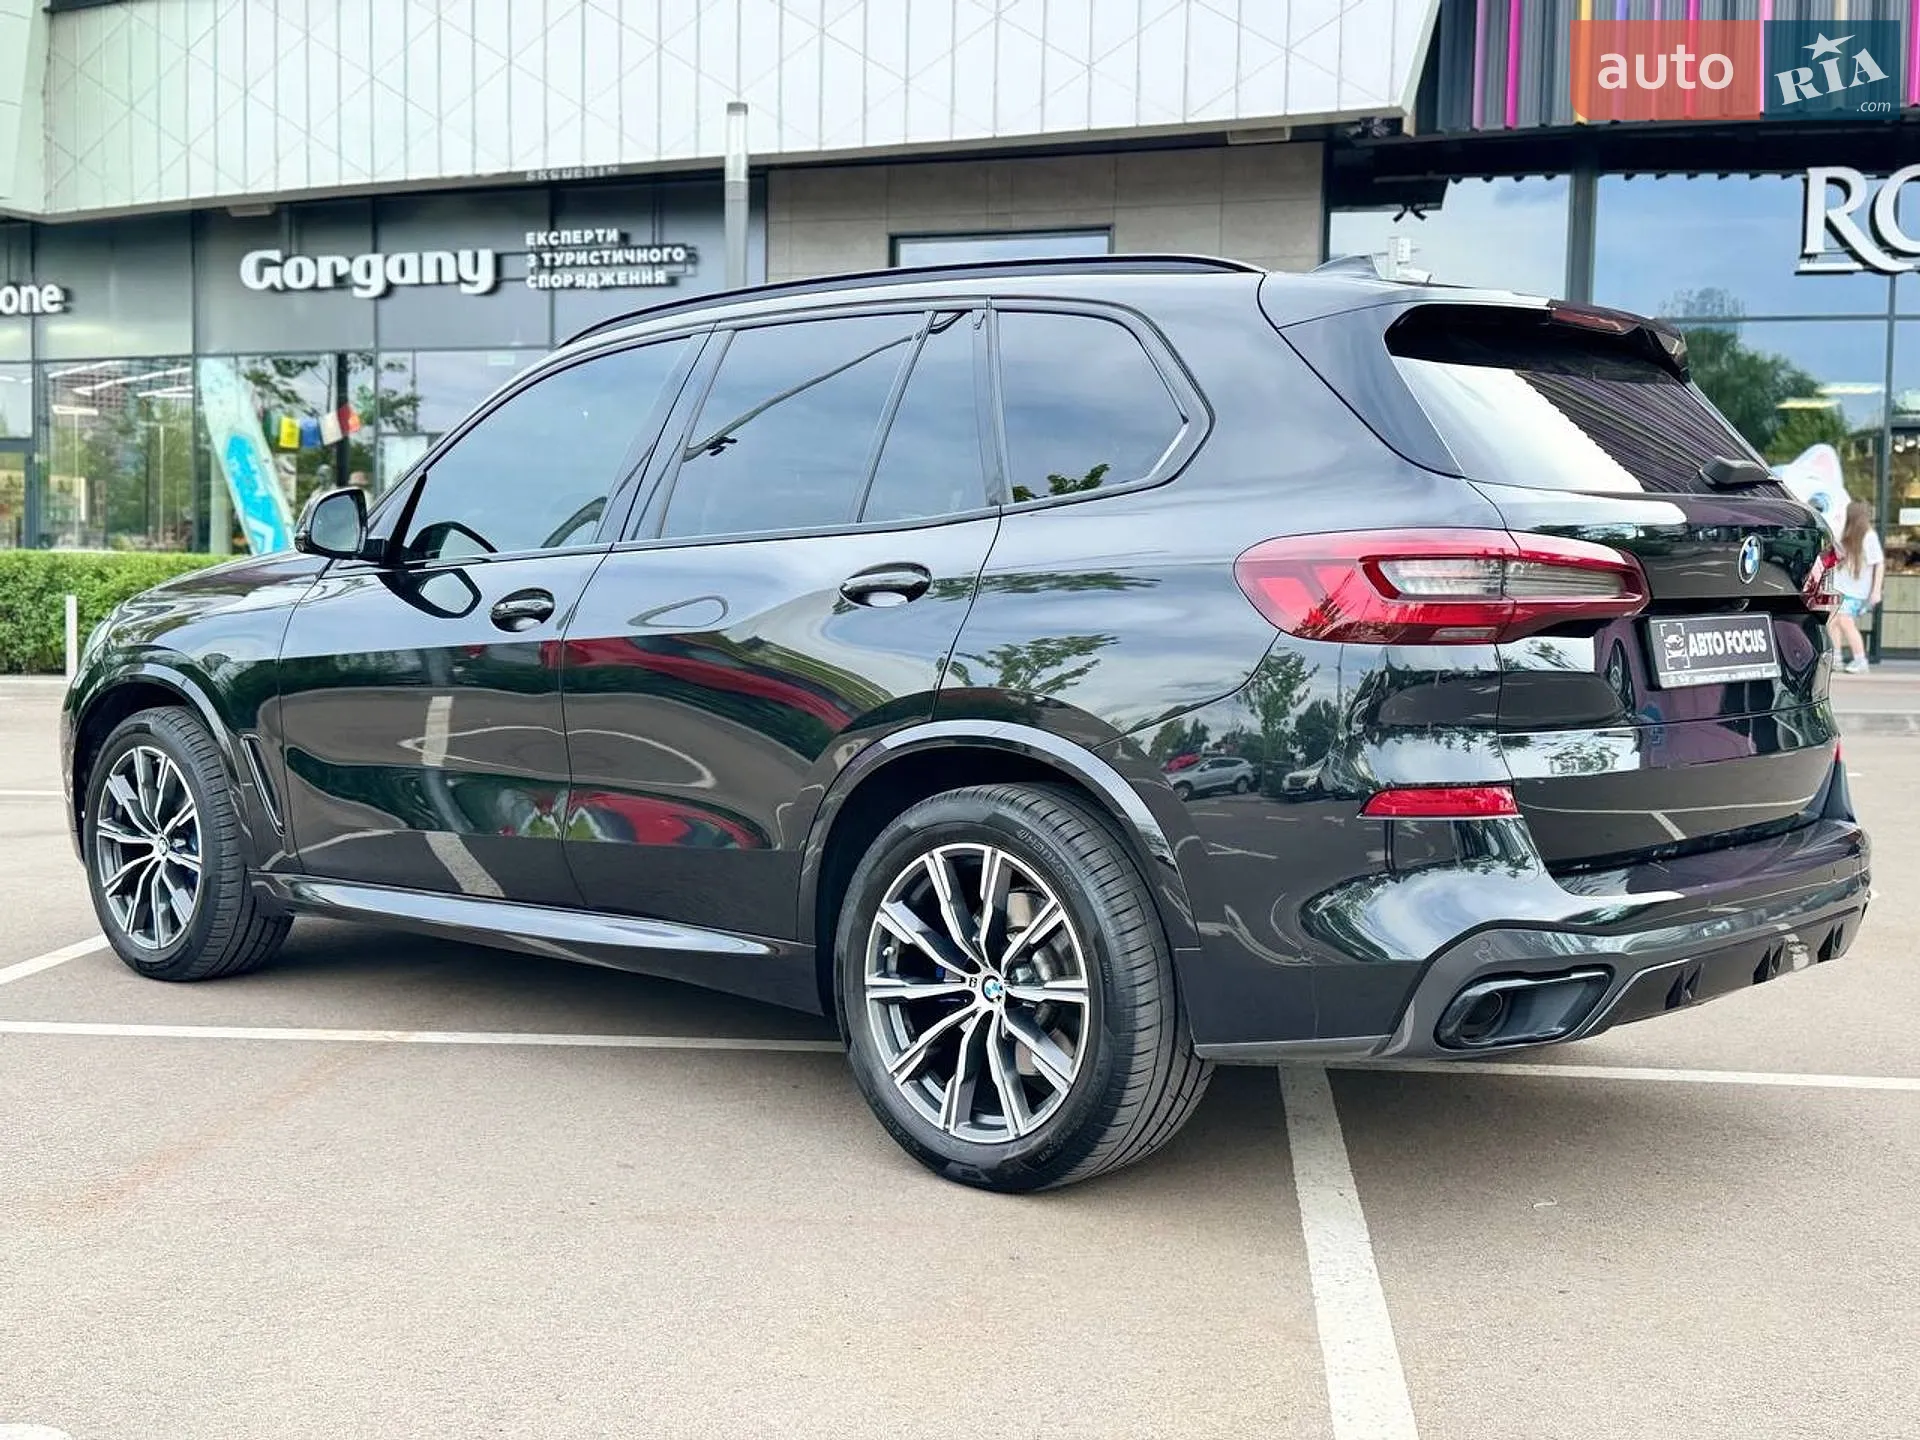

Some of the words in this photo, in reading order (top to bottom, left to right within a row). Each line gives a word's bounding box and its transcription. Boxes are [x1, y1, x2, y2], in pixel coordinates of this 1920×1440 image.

[525, 228, 620, 246] ЕКСПЕРТИ
[526, 253, 538, 268] З
[541, 247, 686, 267] ТУРИСТИЧНОГО
[240, 249, 495, 298] Gorgany
[526, 270, 668, 289] СПОРЯДЖЕННЯ
[0, 284, 65, 314] one
[1687, 631, 1725, 657] АВТО
[1723, 628, 1767, 654] FOCUS
